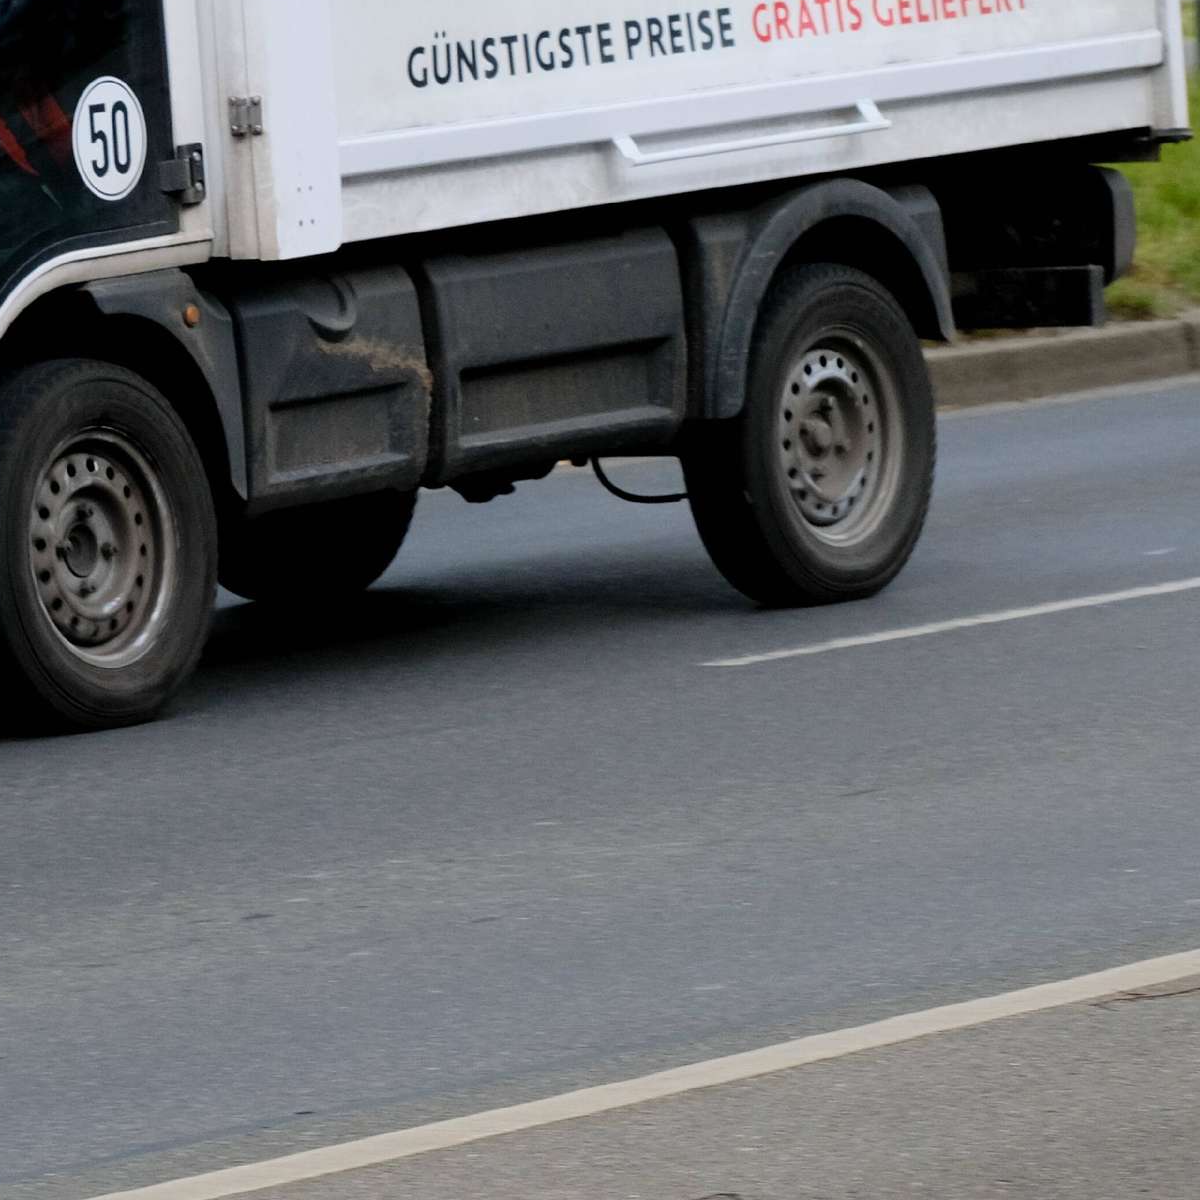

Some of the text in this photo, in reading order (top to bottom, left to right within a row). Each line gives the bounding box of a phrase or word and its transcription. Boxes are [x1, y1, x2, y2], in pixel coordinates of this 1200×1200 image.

[407, 22, 614, 89] GÜNSTIGSTE
[625, 7, 735, 61] PREISE
[88, 100, 132, 178] 50
